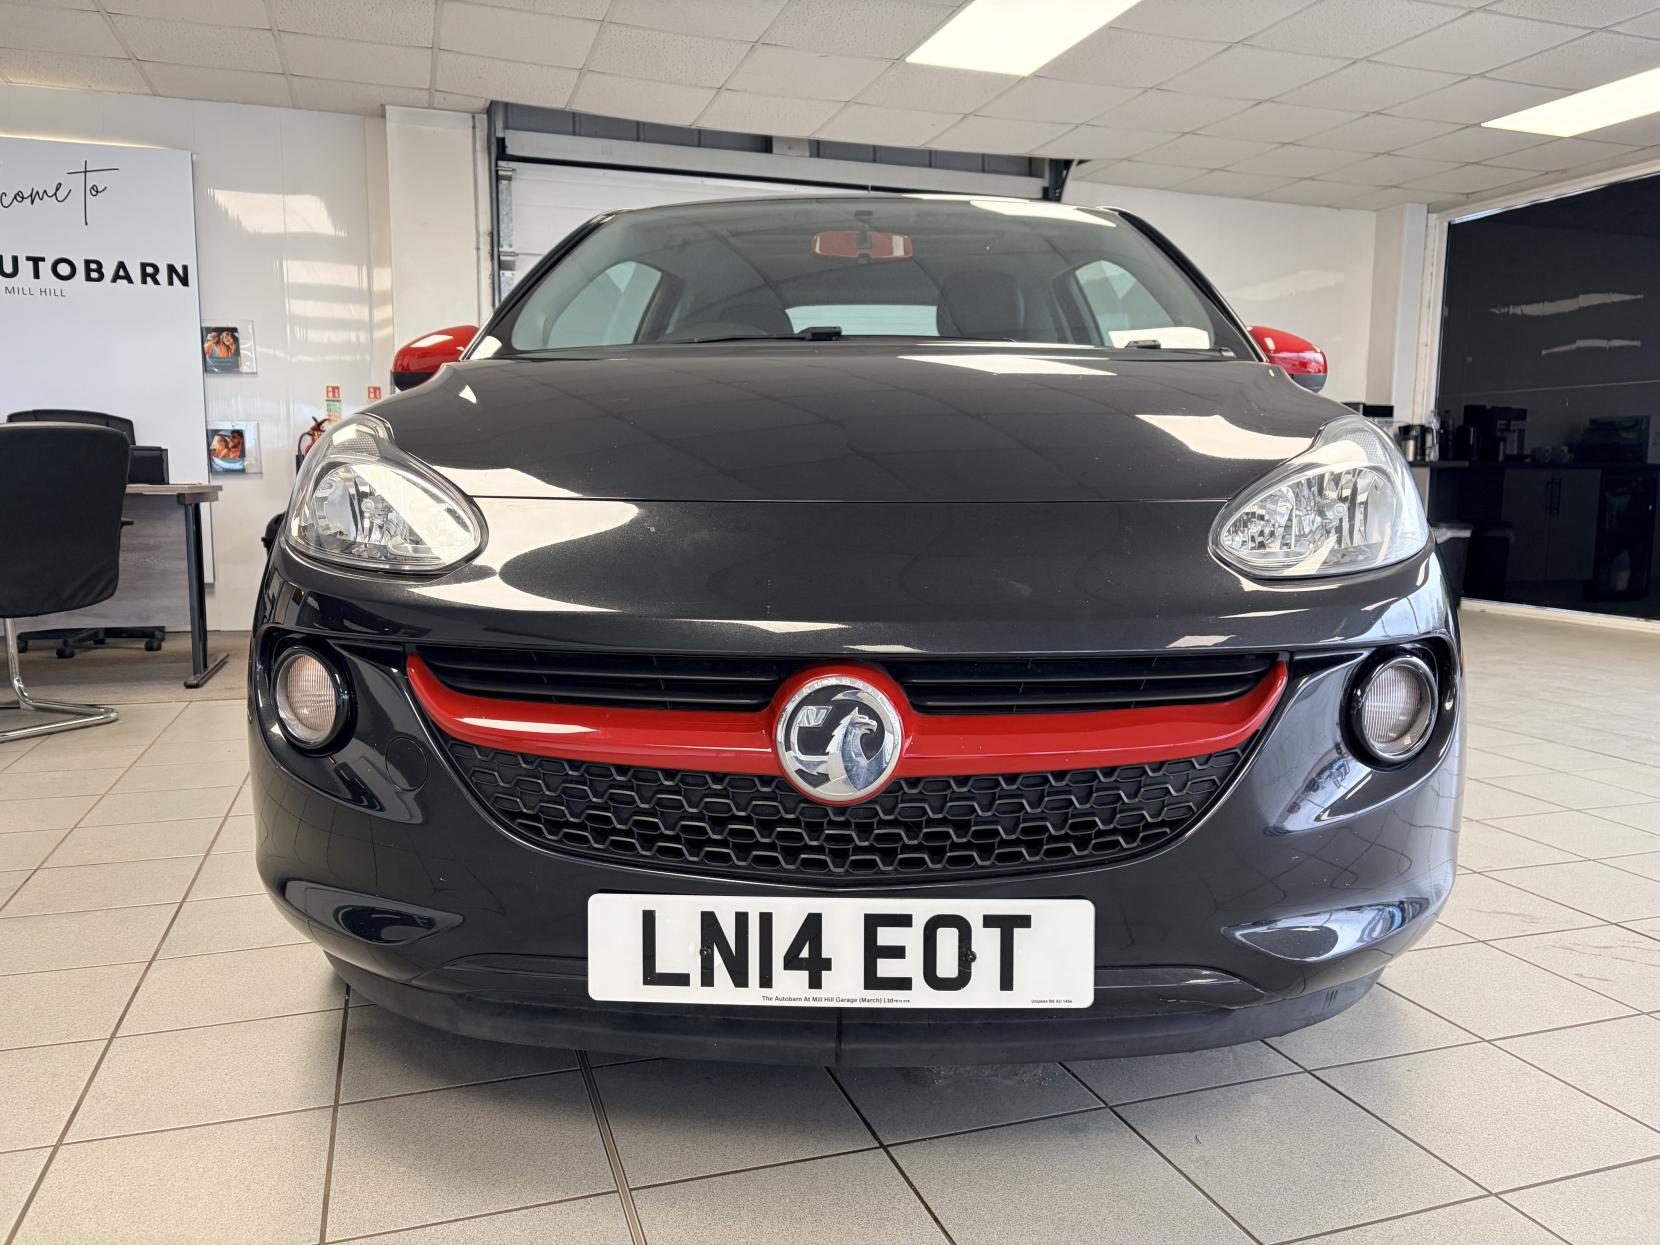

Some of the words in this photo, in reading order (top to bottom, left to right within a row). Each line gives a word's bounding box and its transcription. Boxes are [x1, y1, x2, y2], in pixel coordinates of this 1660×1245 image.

[0, 253, 190, 288] UTOBARN
[4, 286, 35, 296] MILL
[39, 287, 66, 297] HILL
[642, 909, 833, 990] LN14
[863, 913, 1032, 992] EOT
